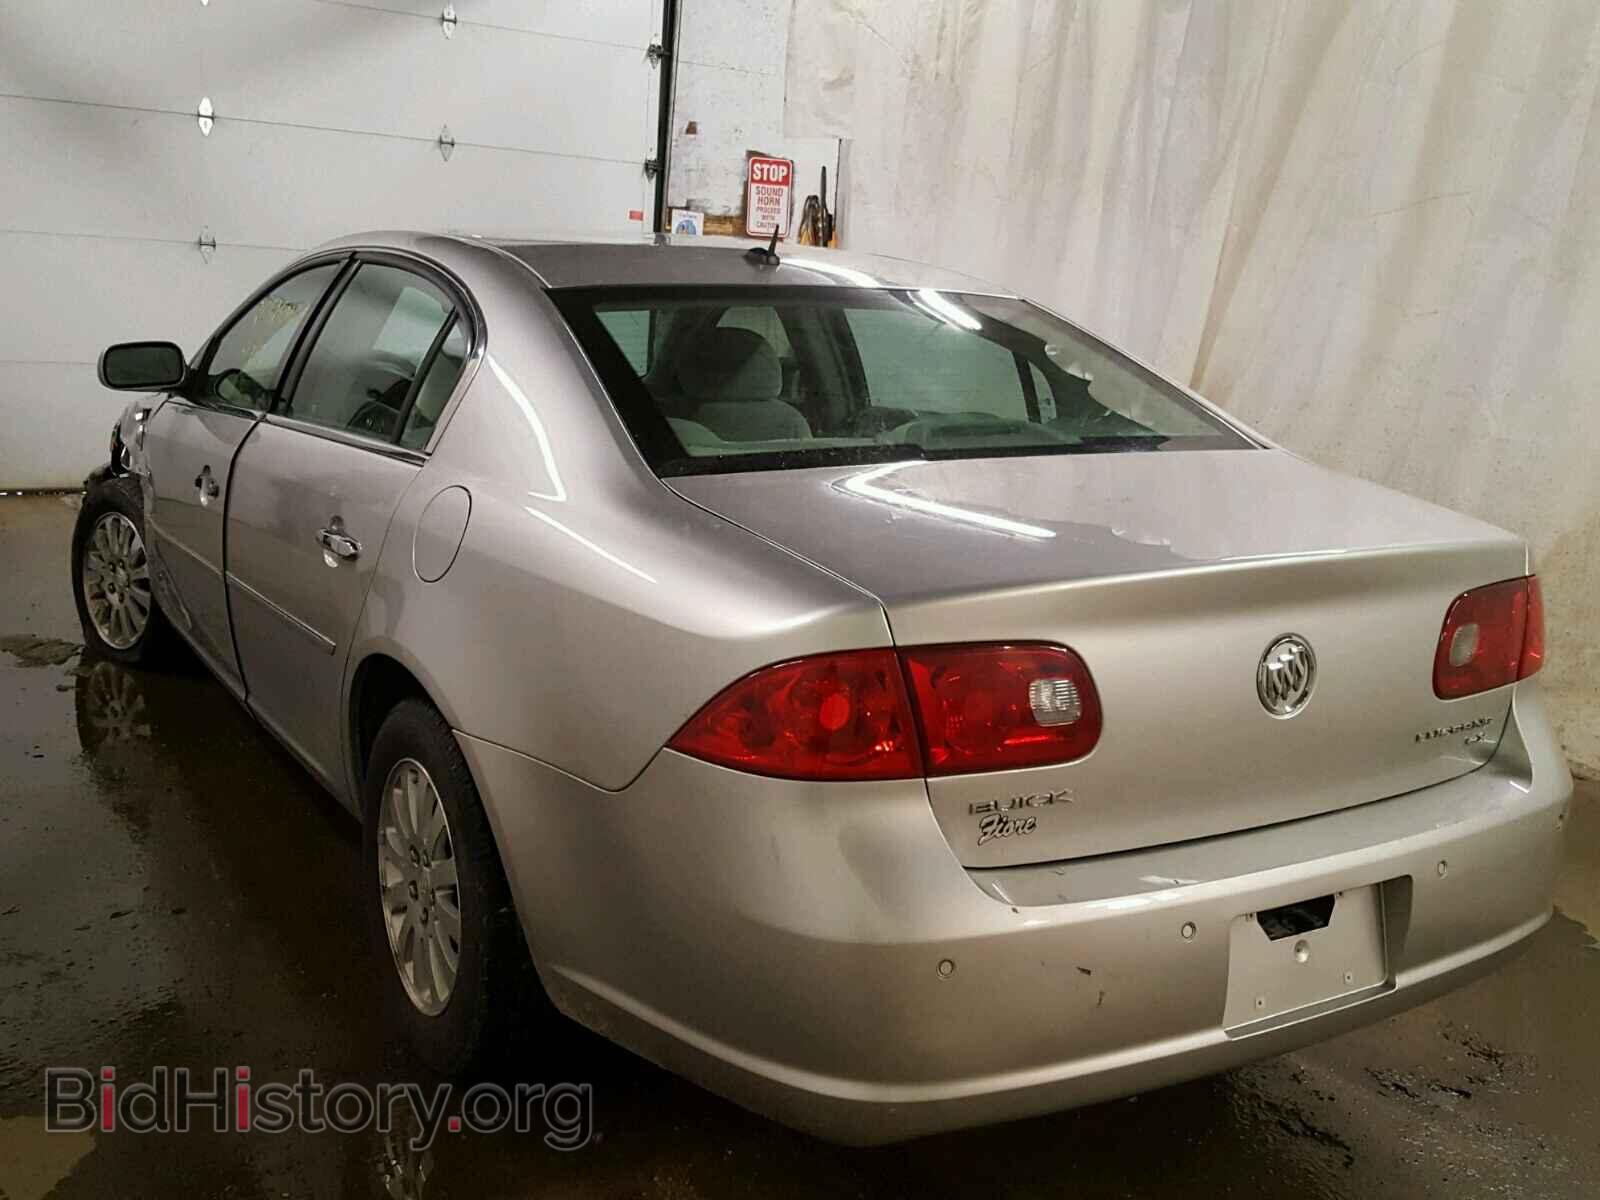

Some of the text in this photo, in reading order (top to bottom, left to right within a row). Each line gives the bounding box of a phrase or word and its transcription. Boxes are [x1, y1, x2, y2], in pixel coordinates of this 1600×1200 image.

[753, 163, 788, 182] STOP
[755, 186, 784, 197] SOUND
[757, 196, 780, 206] HORN
[968, 787, 1073, 816] BUICK
[977, 812, 1038, 847] Fiore
